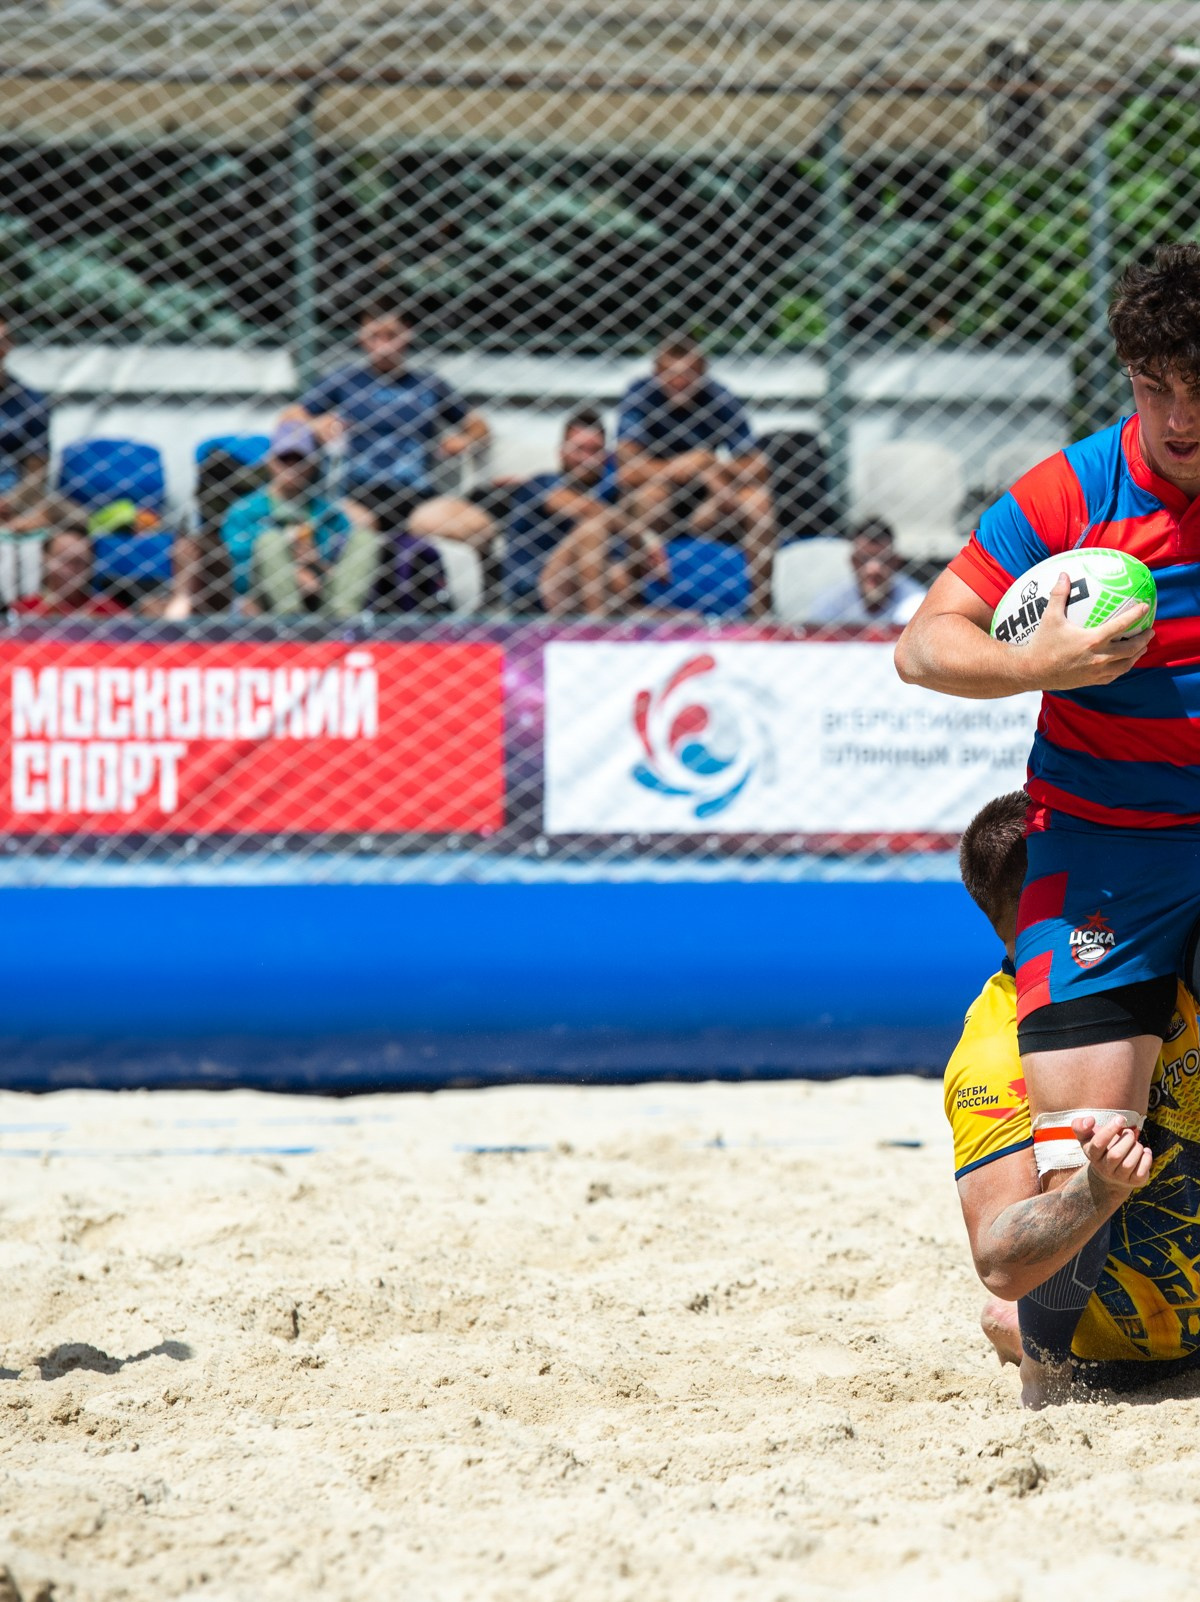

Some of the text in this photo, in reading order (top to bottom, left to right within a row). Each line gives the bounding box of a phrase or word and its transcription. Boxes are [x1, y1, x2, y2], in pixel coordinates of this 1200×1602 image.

[11, 651, 378, 740] МОСКОВСКИЙ
[11, 741, 187, 813] СПОРТ
[1069, 930, 1116, 946] ЦСКА
[957, 1085, 988, 1099] РЕГБИ
[957, 1095, 999, 1110] РОССИИ
